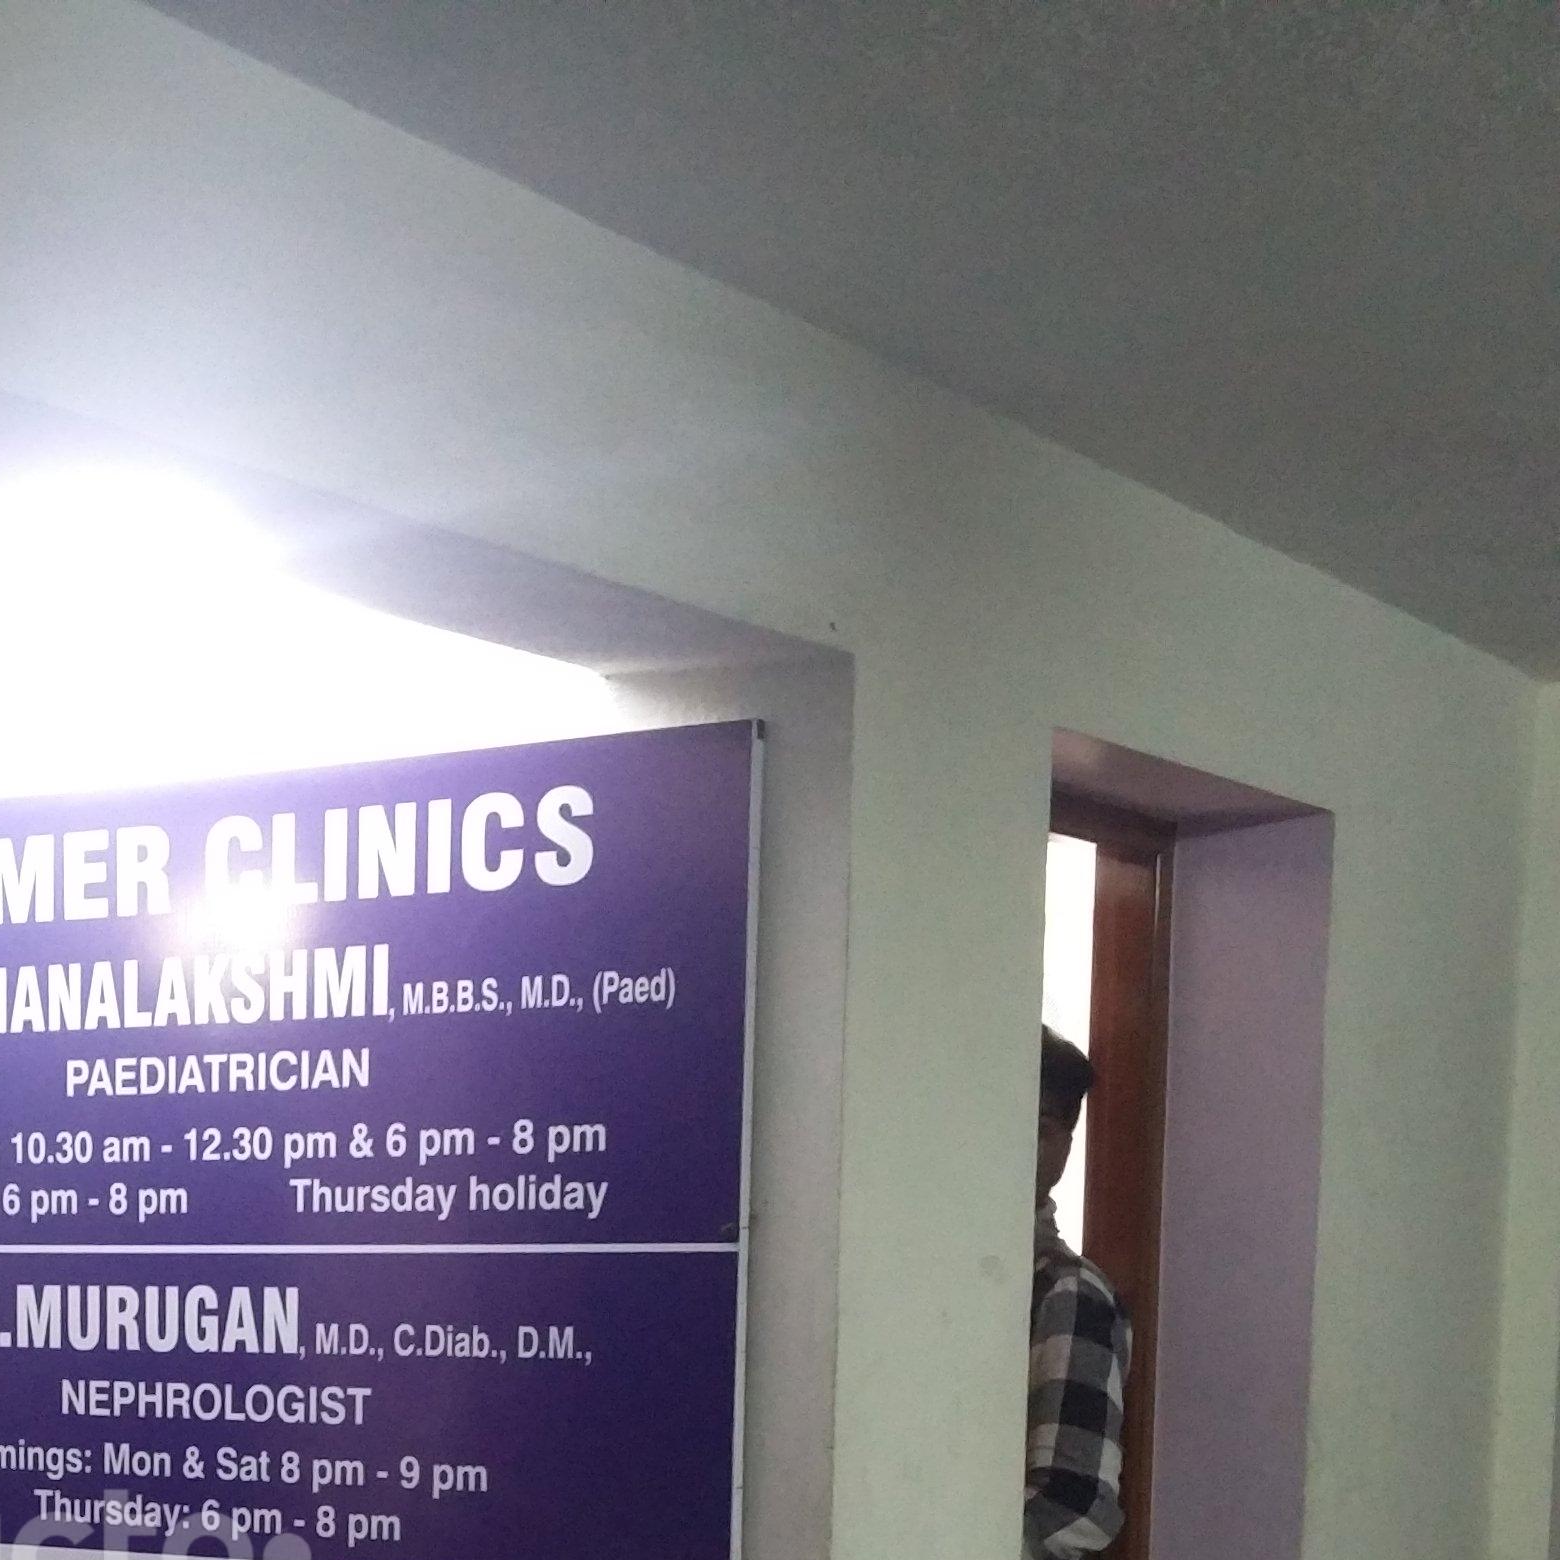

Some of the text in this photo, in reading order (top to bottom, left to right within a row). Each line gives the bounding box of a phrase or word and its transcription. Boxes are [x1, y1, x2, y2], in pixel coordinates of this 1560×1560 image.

[204, 785, 594, 908] CLINICS
[402, 977, 512, 1017] M.B.B.S.,
[521, 974, 583, 1014] M.D.,
[592, 967, 676, 1015] (Paed)
[66, 1047, 370, 1097] PAEDIATRICIAN
[10, 1131, 93, 1165] 10.30
[103, 1134, 151, 1163] am
[183, 1126, 273, 1162] 12.30
[284, 1129, 337, 1169] pm
[349, 1122, 374, 1159] &
[385, 1122, 407, 1158] 6
[419, 1126, 475, 1166] pm
[512, 1118, 535, 1155] 8
[547, 1122, 607, 1163] pm
[2, 1183, 21, 1216] 6
[30, 1187, 78, 1223] pm
[108, 1182, 128, 1215] 8
[138, 1187, 188, 1223] pm
[289, 1174, 609, 1221] Thursday holiday
[315, 1323, 384, 1361] M.D.,
[394, 1324, 506, 1364] C.Diab.,
[517, 1325, 592, 1366] D.M.,
[61, 1379, 372, 1425] NEPHROLOGIST
[104, 1442, 171, 1477] Mon
[182, 1445, 205, 1479] &
[216, 1446, 271, 1482] Sat
[280, 1451, 300, 1484] 8
[312, 1459, 364, 1494] pm
[399, 1456, 420, 1489] 9
[432, 1464, 488, 1499] pm
[34, 1488, 190, 1537] Thursday:
[201, 1499, 221, 1531] 6
[231, 1507, 282, 1541] pm
[316, 1505, 336, 1538] 8
[348, 1513, 401, 1547] pm
